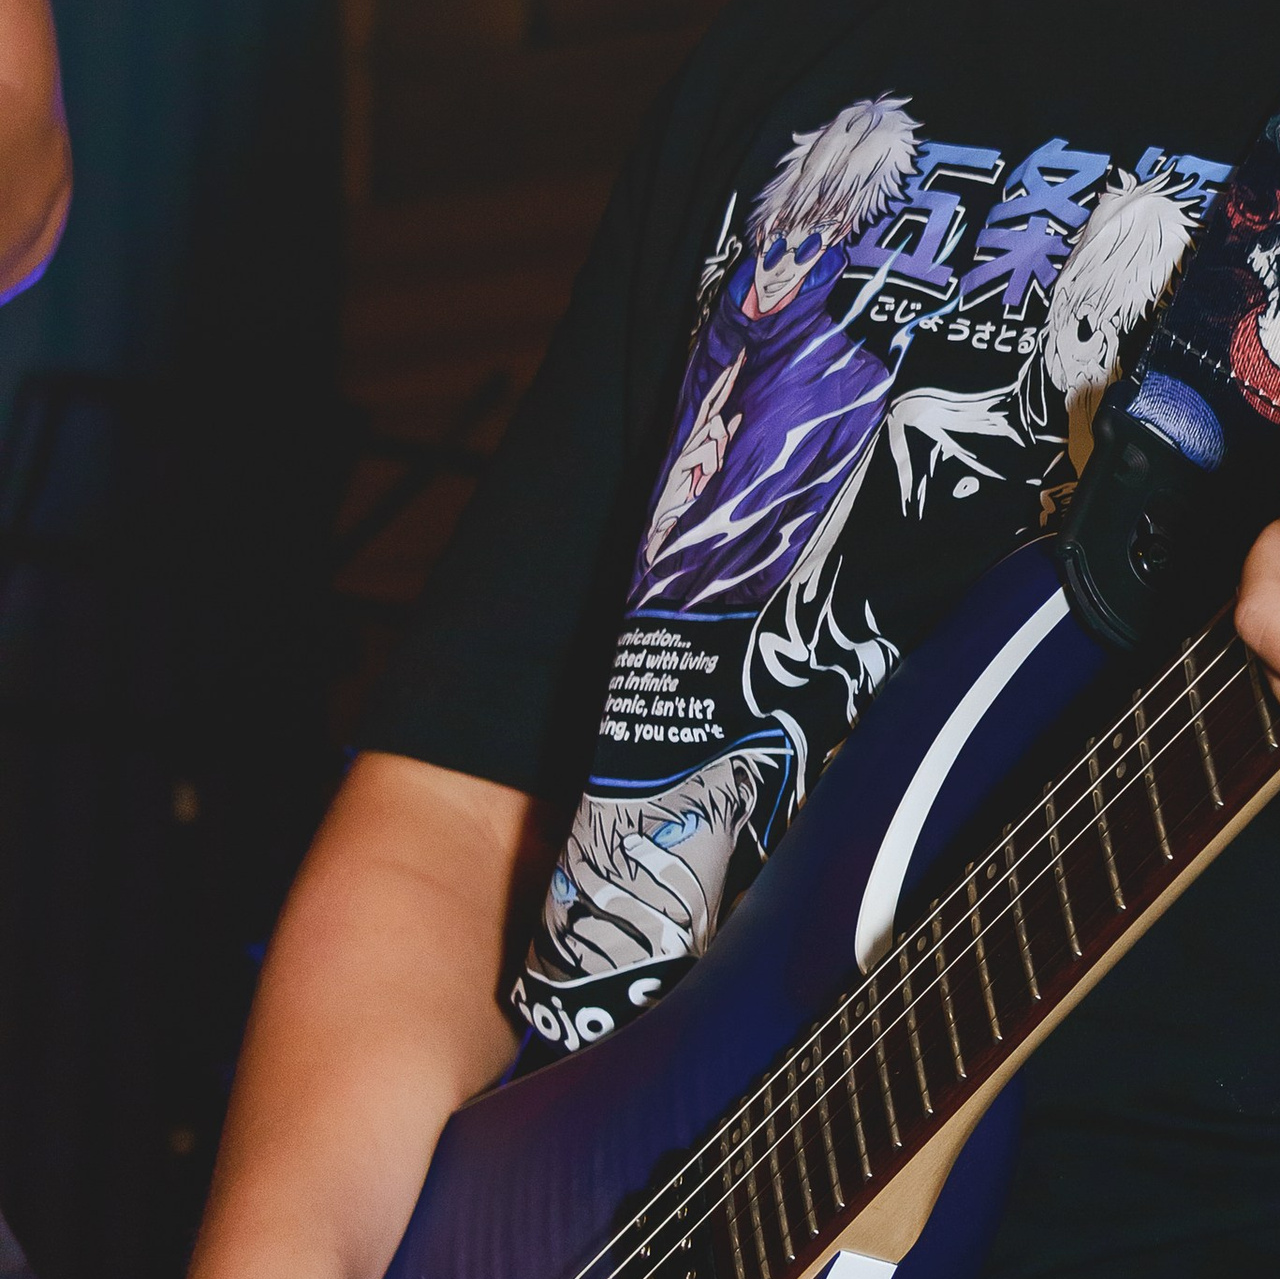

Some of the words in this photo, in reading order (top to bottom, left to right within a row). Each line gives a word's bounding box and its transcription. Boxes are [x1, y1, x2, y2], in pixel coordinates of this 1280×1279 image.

[646, 650, 680, 670] with
[680, 651, 719, 674] living
[625, 671, 680, 692] infinite
[651, 695, 686, 718] isn't
[688, 696, 716, 720] it?
[634, 723, 665, 743] you
[667, 723, 725, 743] can't
